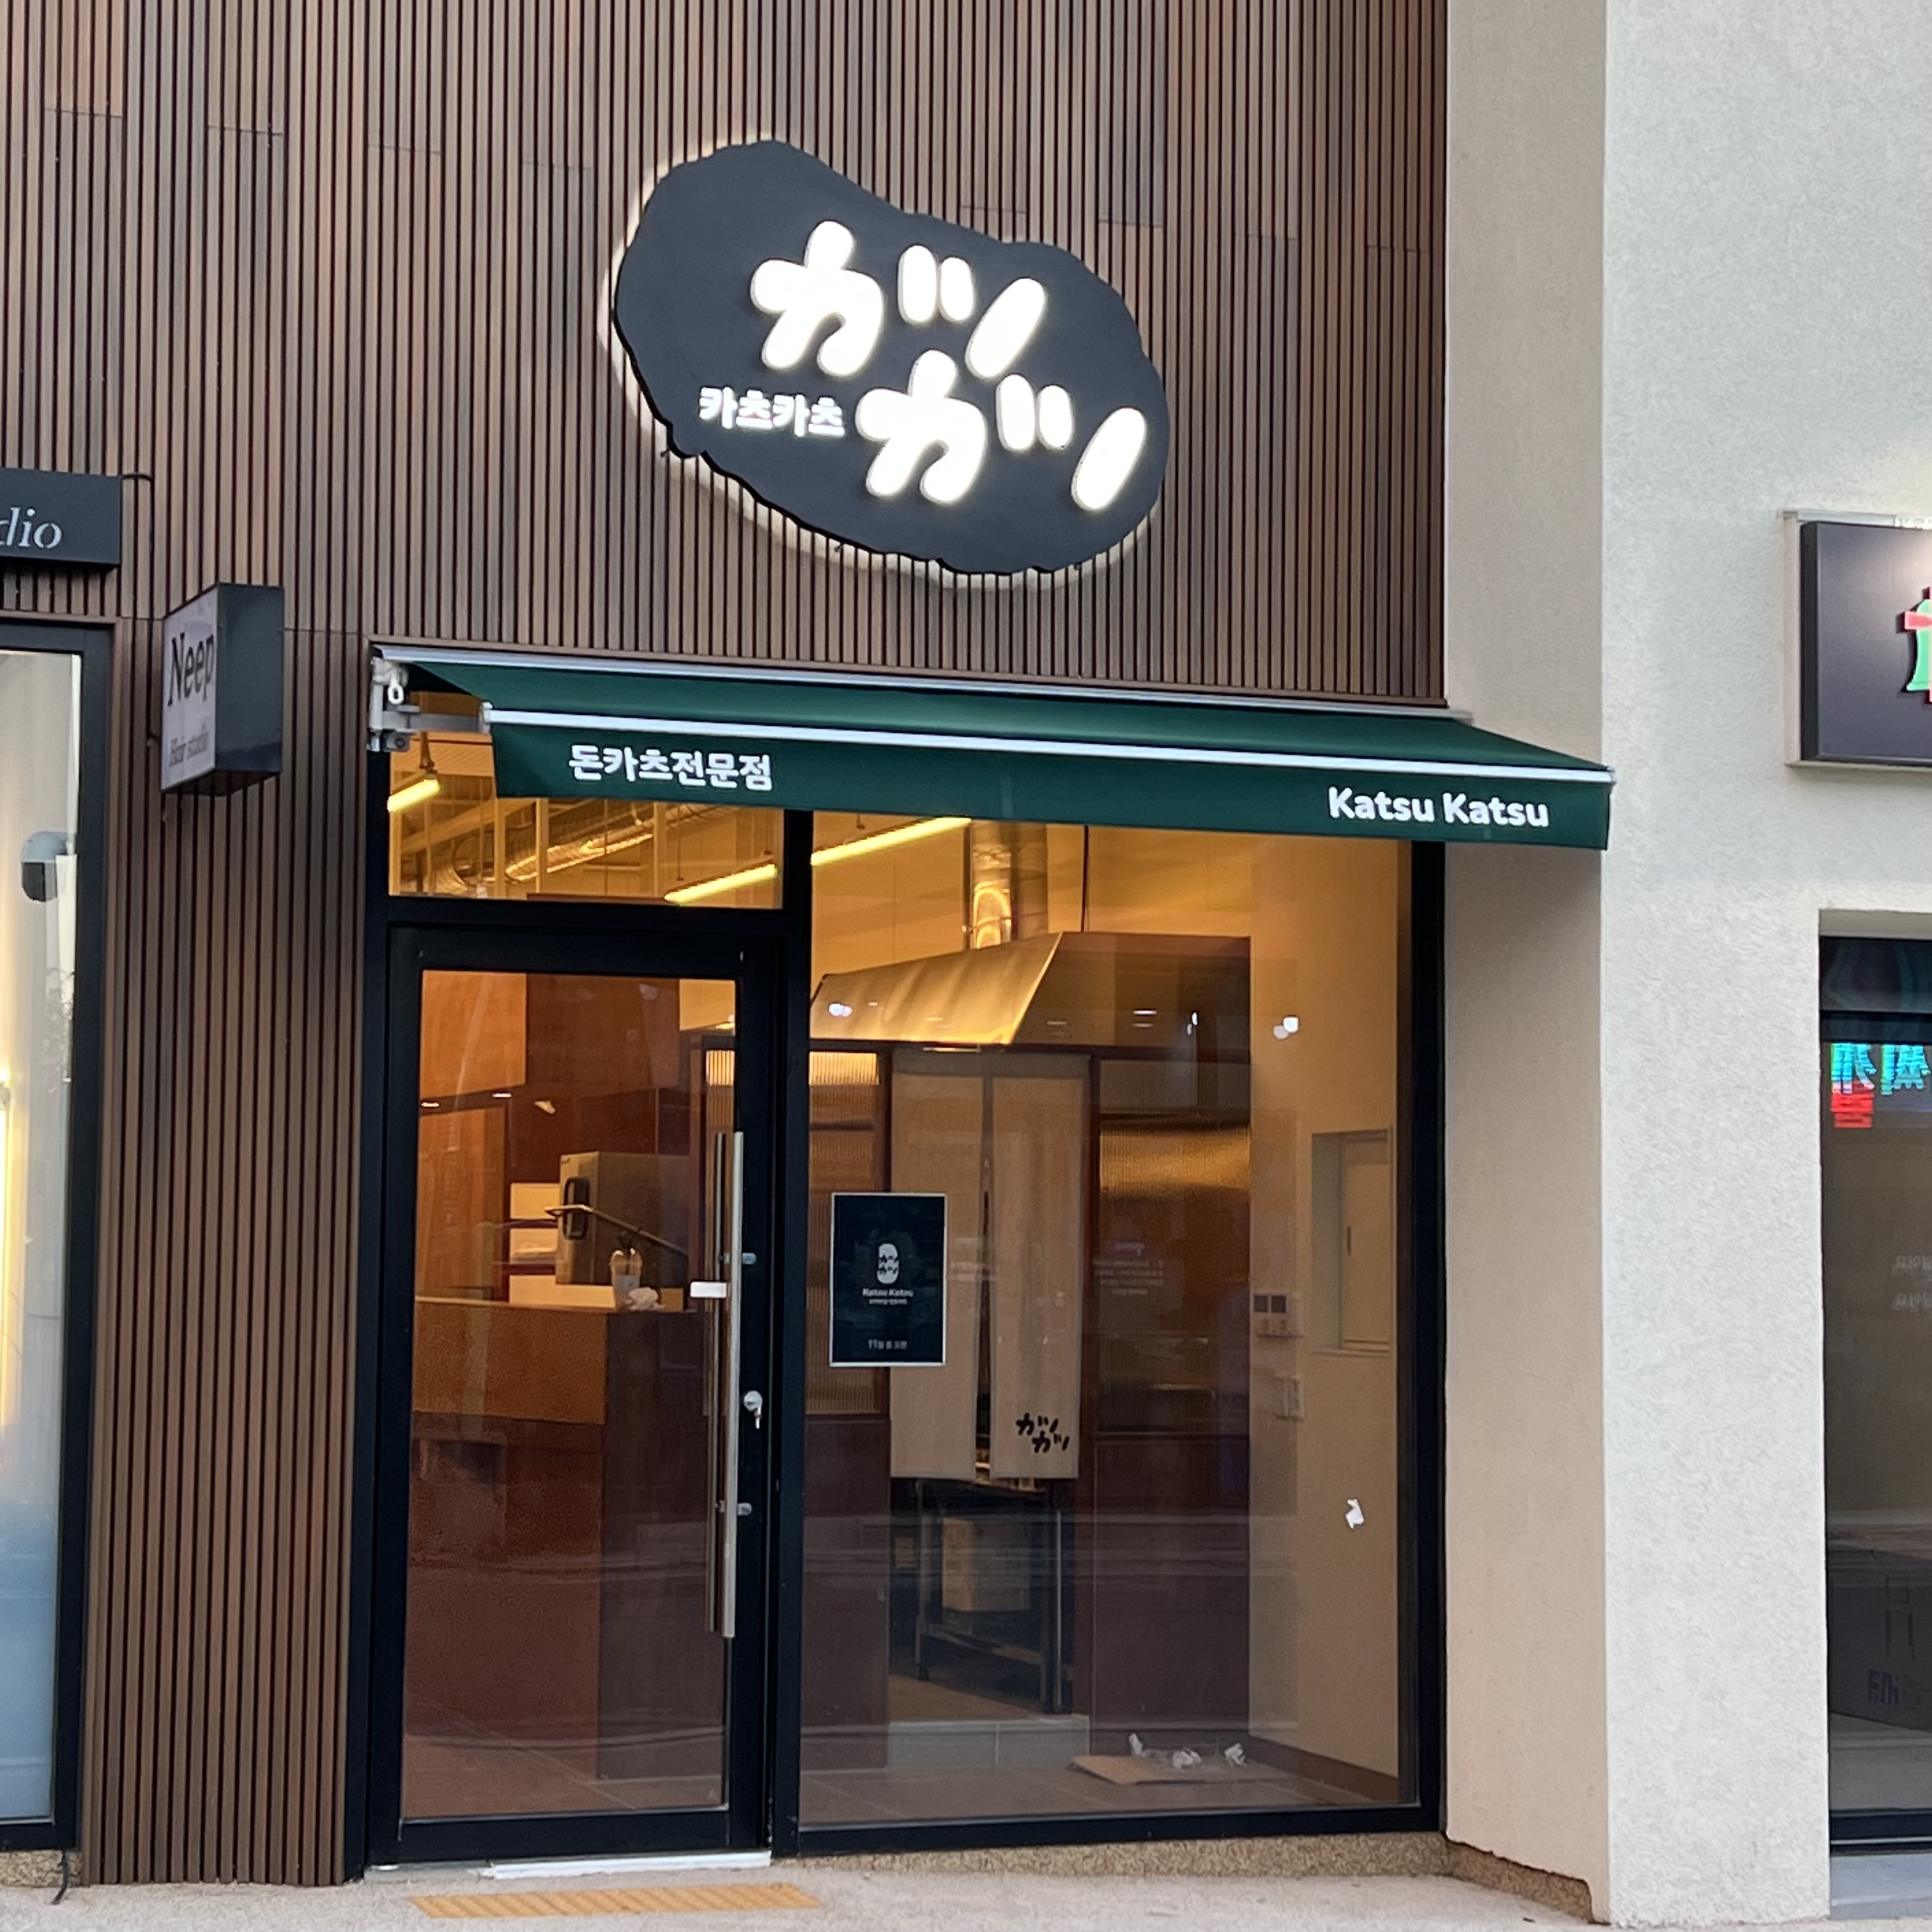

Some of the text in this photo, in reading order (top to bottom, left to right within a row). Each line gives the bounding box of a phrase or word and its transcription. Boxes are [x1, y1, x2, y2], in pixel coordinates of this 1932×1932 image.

[698, 386, 845, 437] 카츠카츠
[167, 632, 214, 706] Neep
[569, 745, 772, 791] 돈카츠전문점
[1328, 786, 1549, 827] Katsu Katsu
